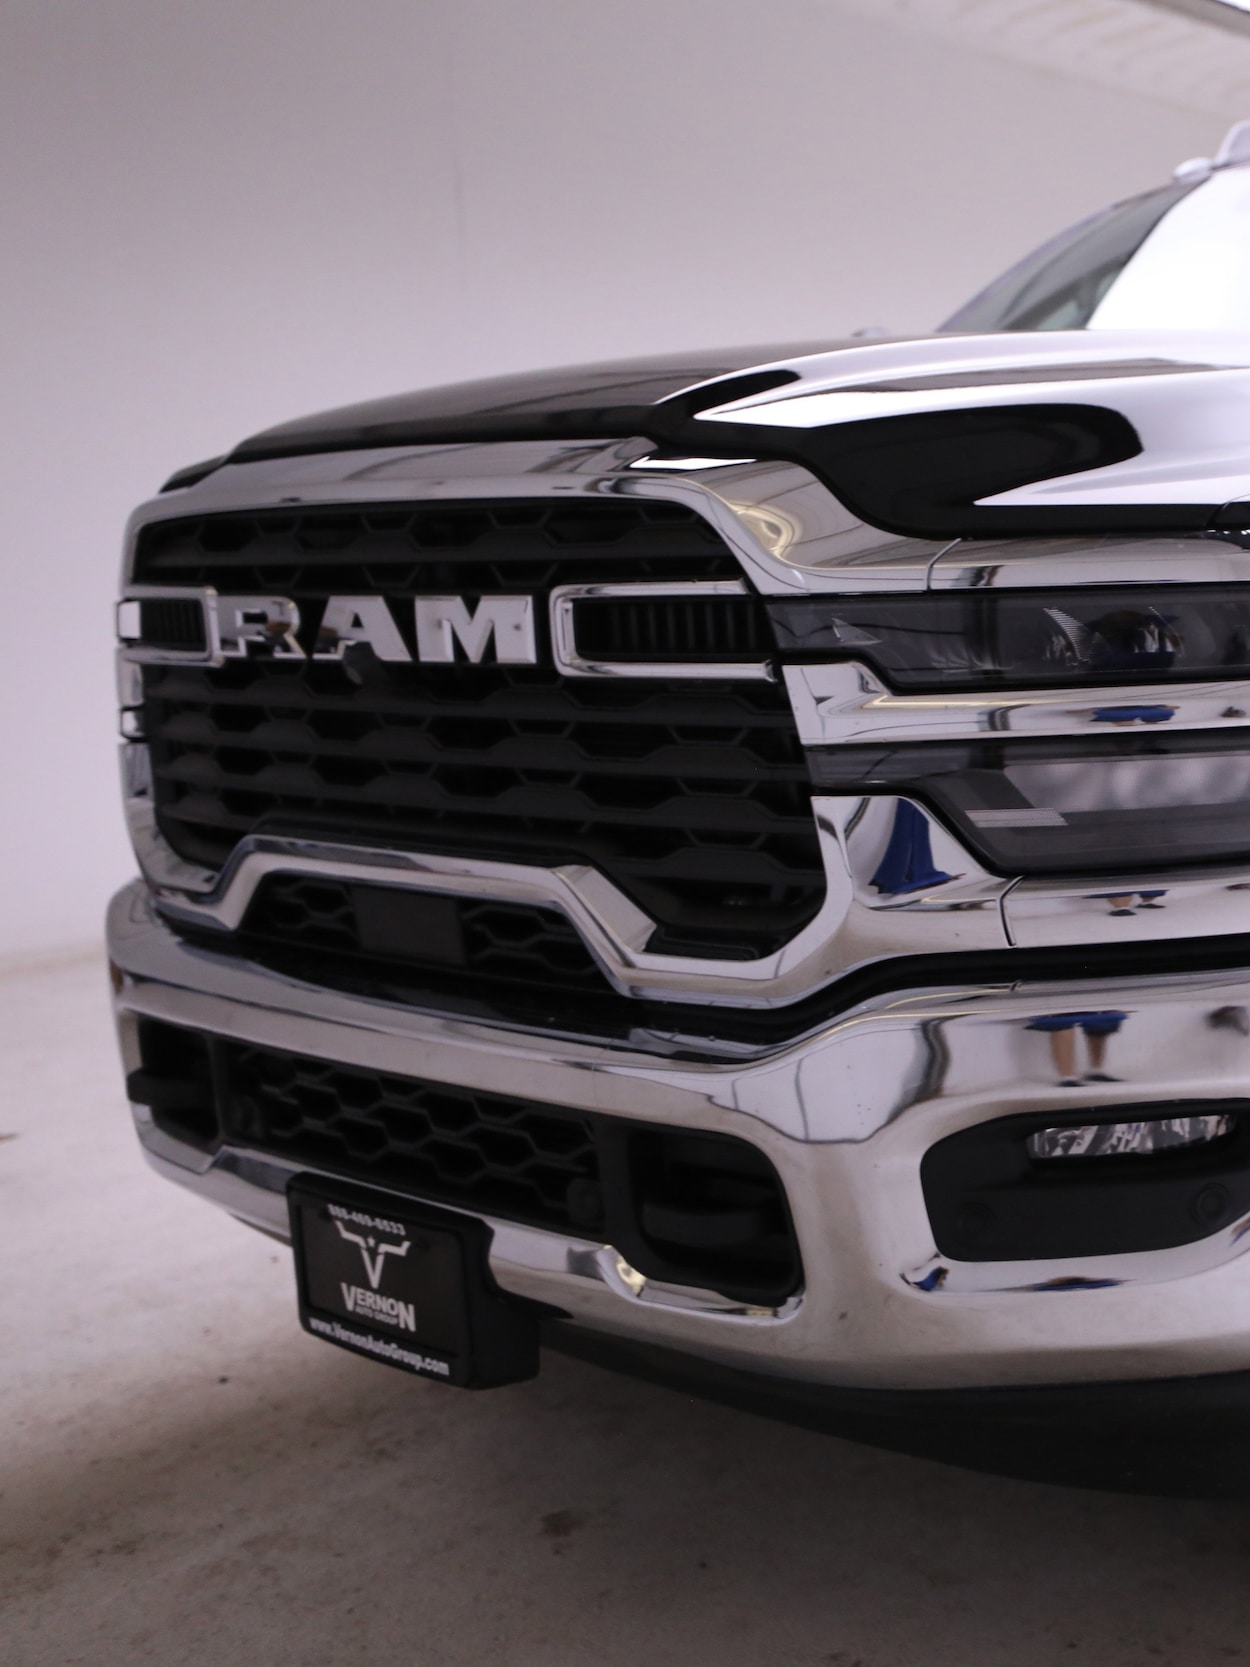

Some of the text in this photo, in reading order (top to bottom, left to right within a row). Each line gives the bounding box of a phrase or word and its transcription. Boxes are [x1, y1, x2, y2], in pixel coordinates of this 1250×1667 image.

[213, 594, 538, 664] RAM
[341, 1282, 416, 1332] VERNON
[309, 1317, 450, 1376] www.VernonAutoGroup.com
